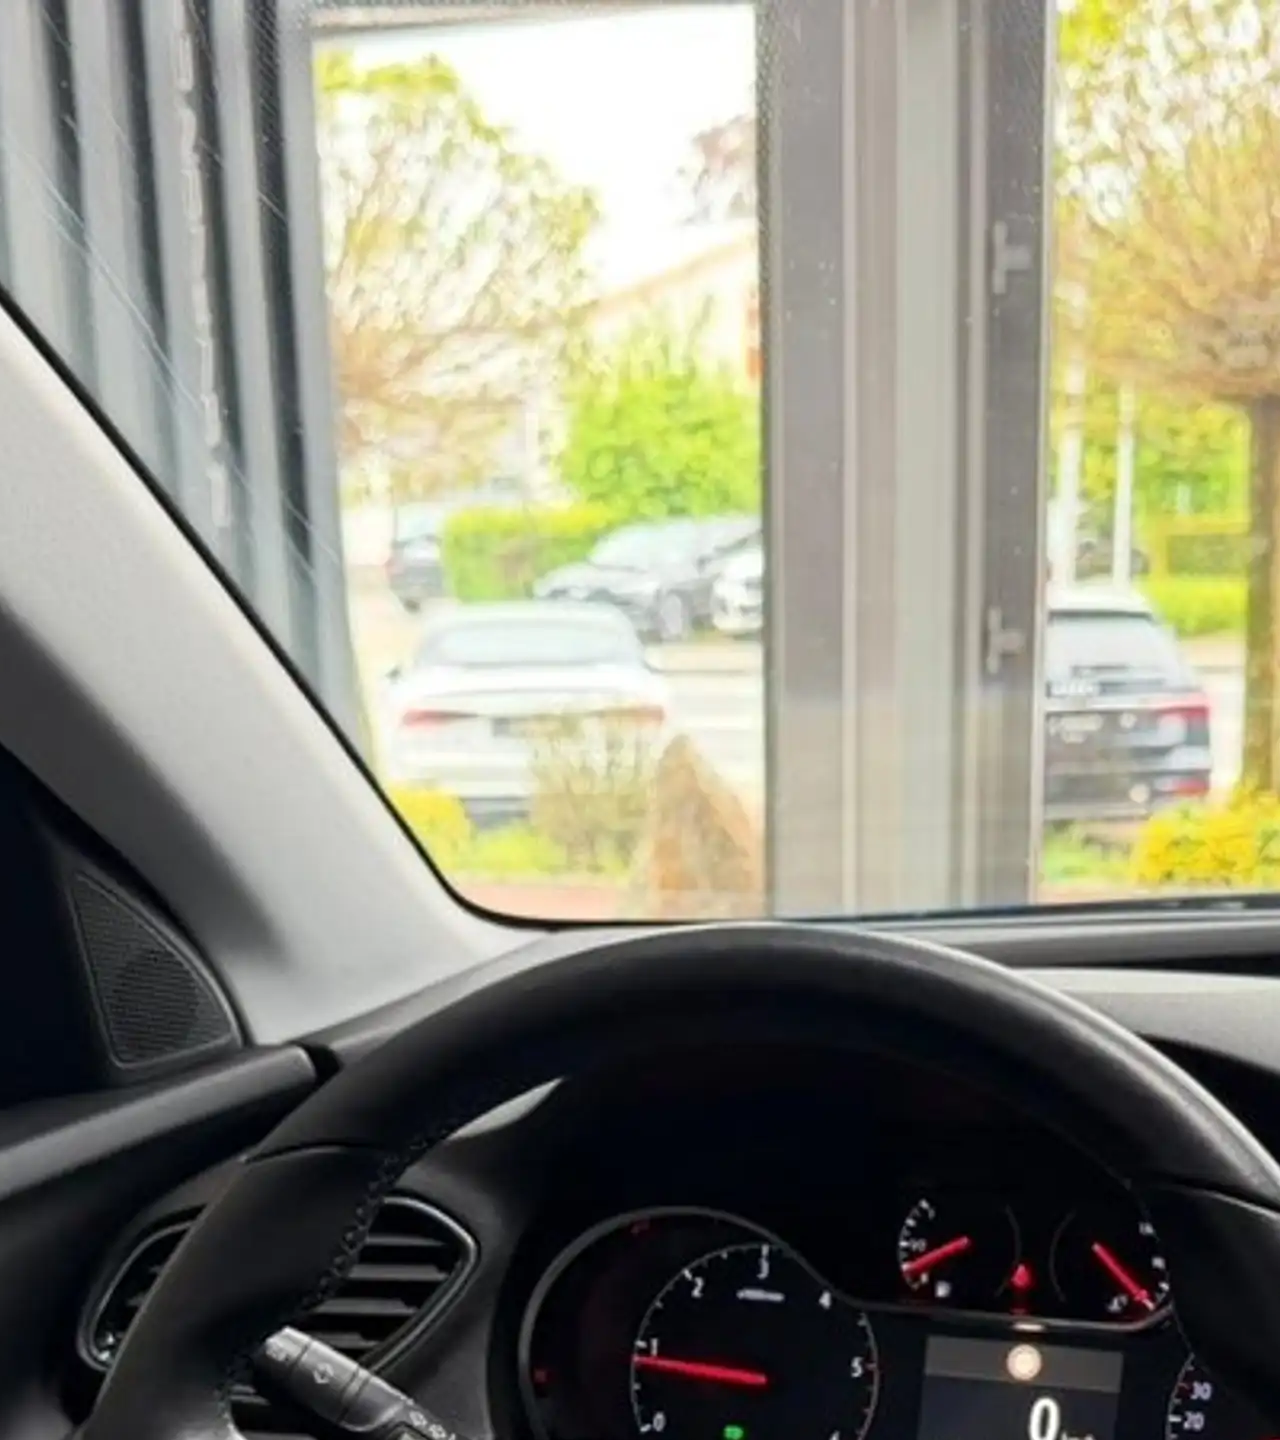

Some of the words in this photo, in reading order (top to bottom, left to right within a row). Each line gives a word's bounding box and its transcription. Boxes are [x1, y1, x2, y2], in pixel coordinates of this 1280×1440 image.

[691, 1276, 704, 1298] 2
[851, 1357, 863, 1378] 5
[652, 1412, 666, 1432] 0
[1183, 1412, 1205, 1431] 20
